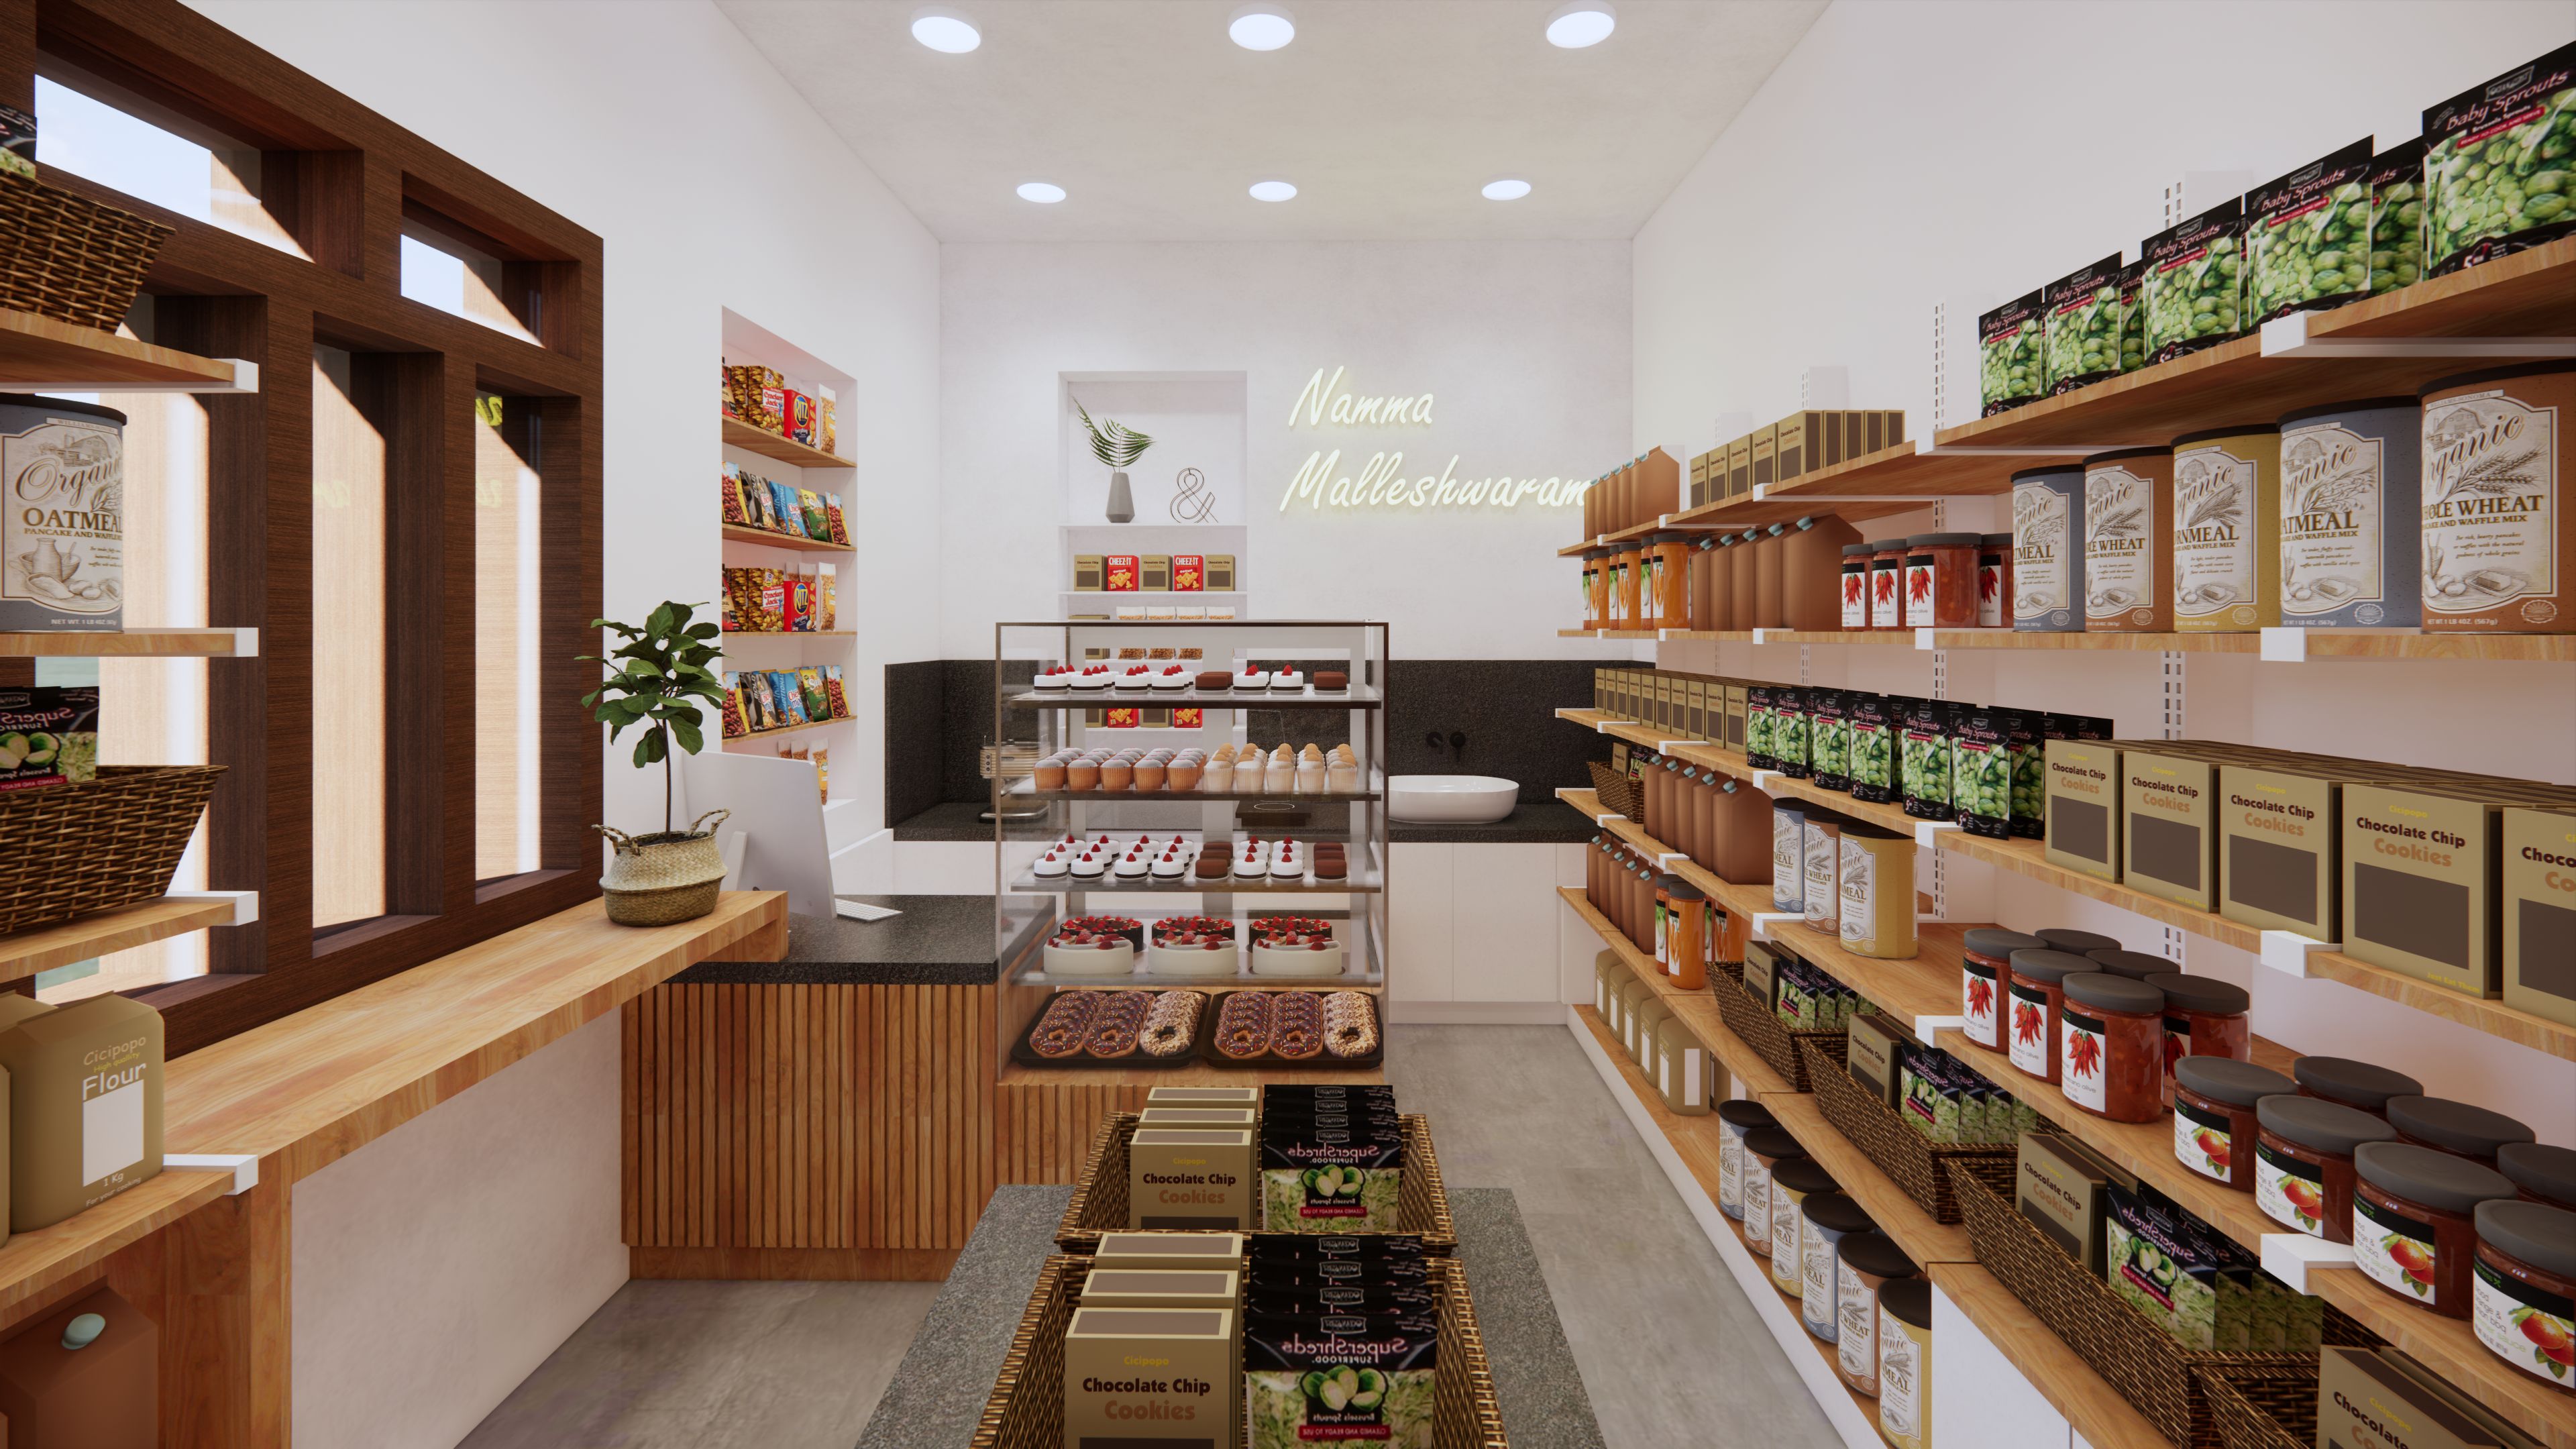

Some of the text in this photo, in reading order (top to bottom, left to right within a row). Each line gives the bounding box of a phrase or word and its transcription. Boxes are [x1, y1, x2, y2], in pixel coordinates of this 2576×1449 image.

[2446, 103, 2489, 131] Baby
[2491, 70, 2569, 112] Sprouts
[2261, 189, 2290, 213] Baby
[2293, 168, 2347, 205] Sprouts
[2153, 223, 2220, 259] Baby Sprouts
[2053, 274, 2105, 303] Baby Sprouts
[1986, 307, 2029, 333] Baby Sprouts
[1289, 366, 1434, 427] Namma
[794, 399, 809, 421] RITZ
[15, 451, 122, 508] Organi
[1279, 449, 1591, 512] Malleshwaram
[2457, 494, 2544, 515] WHEAT
[24, 527, 72, 537] PANCAKE
[2458, 516, 2500, 526] WAFFLE
[2099, 538, 2145, 551] WHEAT
[2305, 532, 2337, 540] WAFFLE
[794, 588, 809, 610] RITZ
[1958, 724, 1998, 740] Baby Sprouts
[2051, 762, 2106, 782] Chocolate Chip
[2060, 776, 2100, 794] Cookies
[2131, 776, 2199, 799] Chocolate Chip
[2142, 792, 2191, 813] Cookies
[2231, 794, 2315, 820] Chocolate Chip
[2244, 812, 2305, 837] Cookies
[2356, 816, 2466, 849] Chocolate Chip
[2373, 837, 2453, 867] Cookies
[2521, 846, 2576, 868] Choco
[83, 1036, 146, 1066] Cicipopo
[1852, 1034, 1885, 1065] Chocolate Chip
[82, 1063, 147, 1101] Flour
[1173, 1157, 1207, 1167] Cicipopo
[111, 1172, 124, 1185] Kg
[1142, 1173, 1236, 1187] Chocolate Chip
[2025, 1162, 2082, 1211] Chocolate Chip
[86, 1176, 142, 1208] For your cooking
[1159, 1189, 1226, 1204] Cookies
[2033, 1183, 2074, 1222] Cookies
[1123, 1355, 1170, 1367] Cicipopo
[1082, 1377, 1211, 1397] Chocolate Chip
[1104, 1399, 1196, 1421] Cookies
